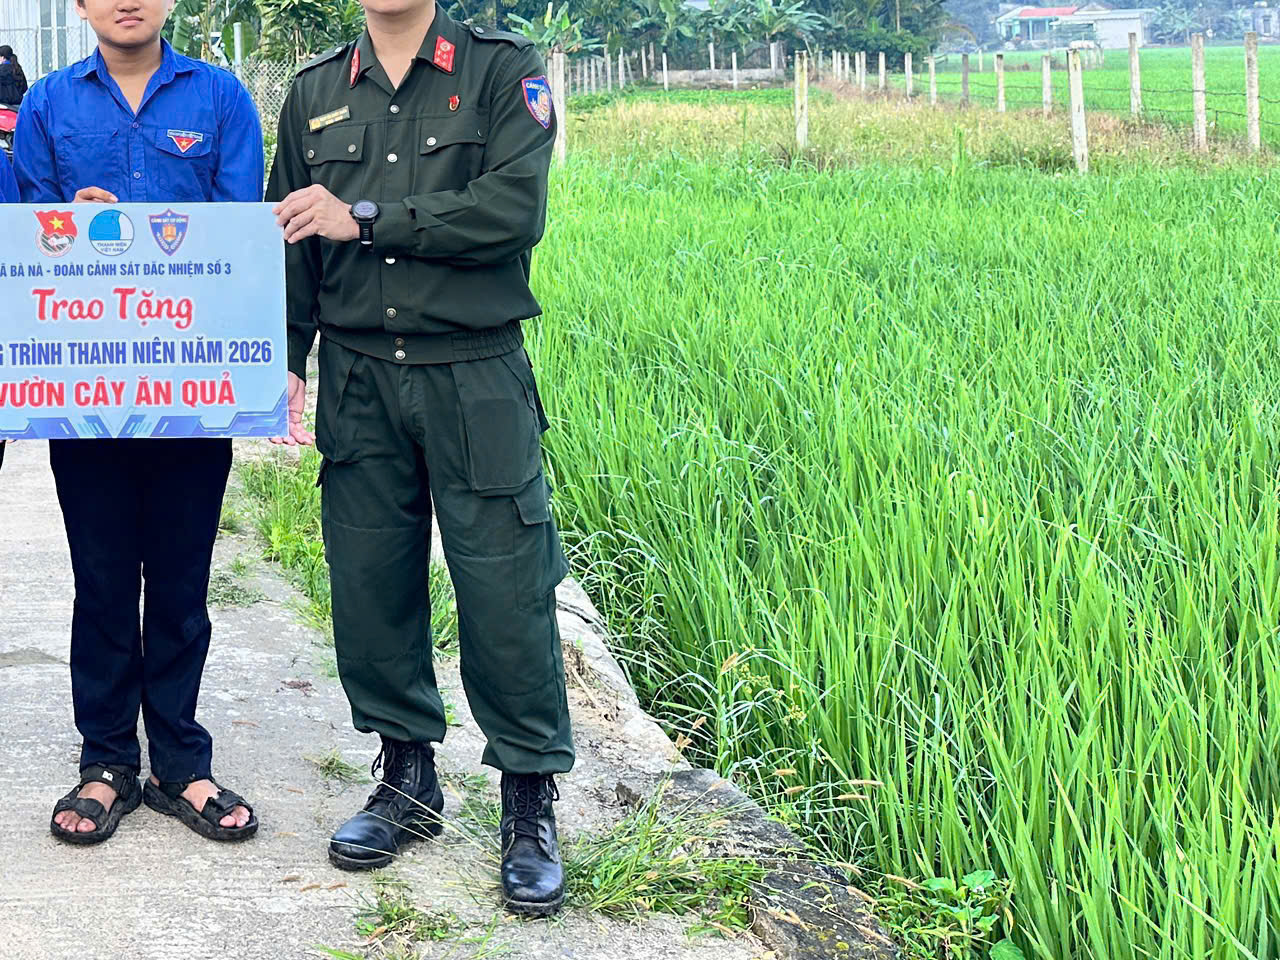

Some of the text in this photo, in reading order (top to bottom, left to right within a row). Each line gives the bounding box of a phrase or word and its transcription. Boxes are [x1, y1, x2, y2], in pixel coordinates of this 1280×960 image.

[10, 262, 25, 277] BÀ
[28, 262, 43, 277] NÀ
[54, 262, 84, 276] ĐOÀN
[87, 260, 117, 276] CẢNH
[120, 261, 140, 276] SÁT
[168, 260, 204, 278] NHIỆM
[207, 258, 221, 275] SỐ
[224, 262, 232, 275] 3
[32, 286, 193, 330] Trao Tặng
[9, 338, 62, 366] TRÌNH
[68, 341, 126, 365] THANH
[132, 336, 175, 364] NIÊN
[181, 336, 223, 363] NĂM
[228, 340, 272, 363] 2026
[74, 375, 126, 407] CÂY
[135, 375, 172, 406] ĂN
[182, 371, 236, 408] QUẢ
